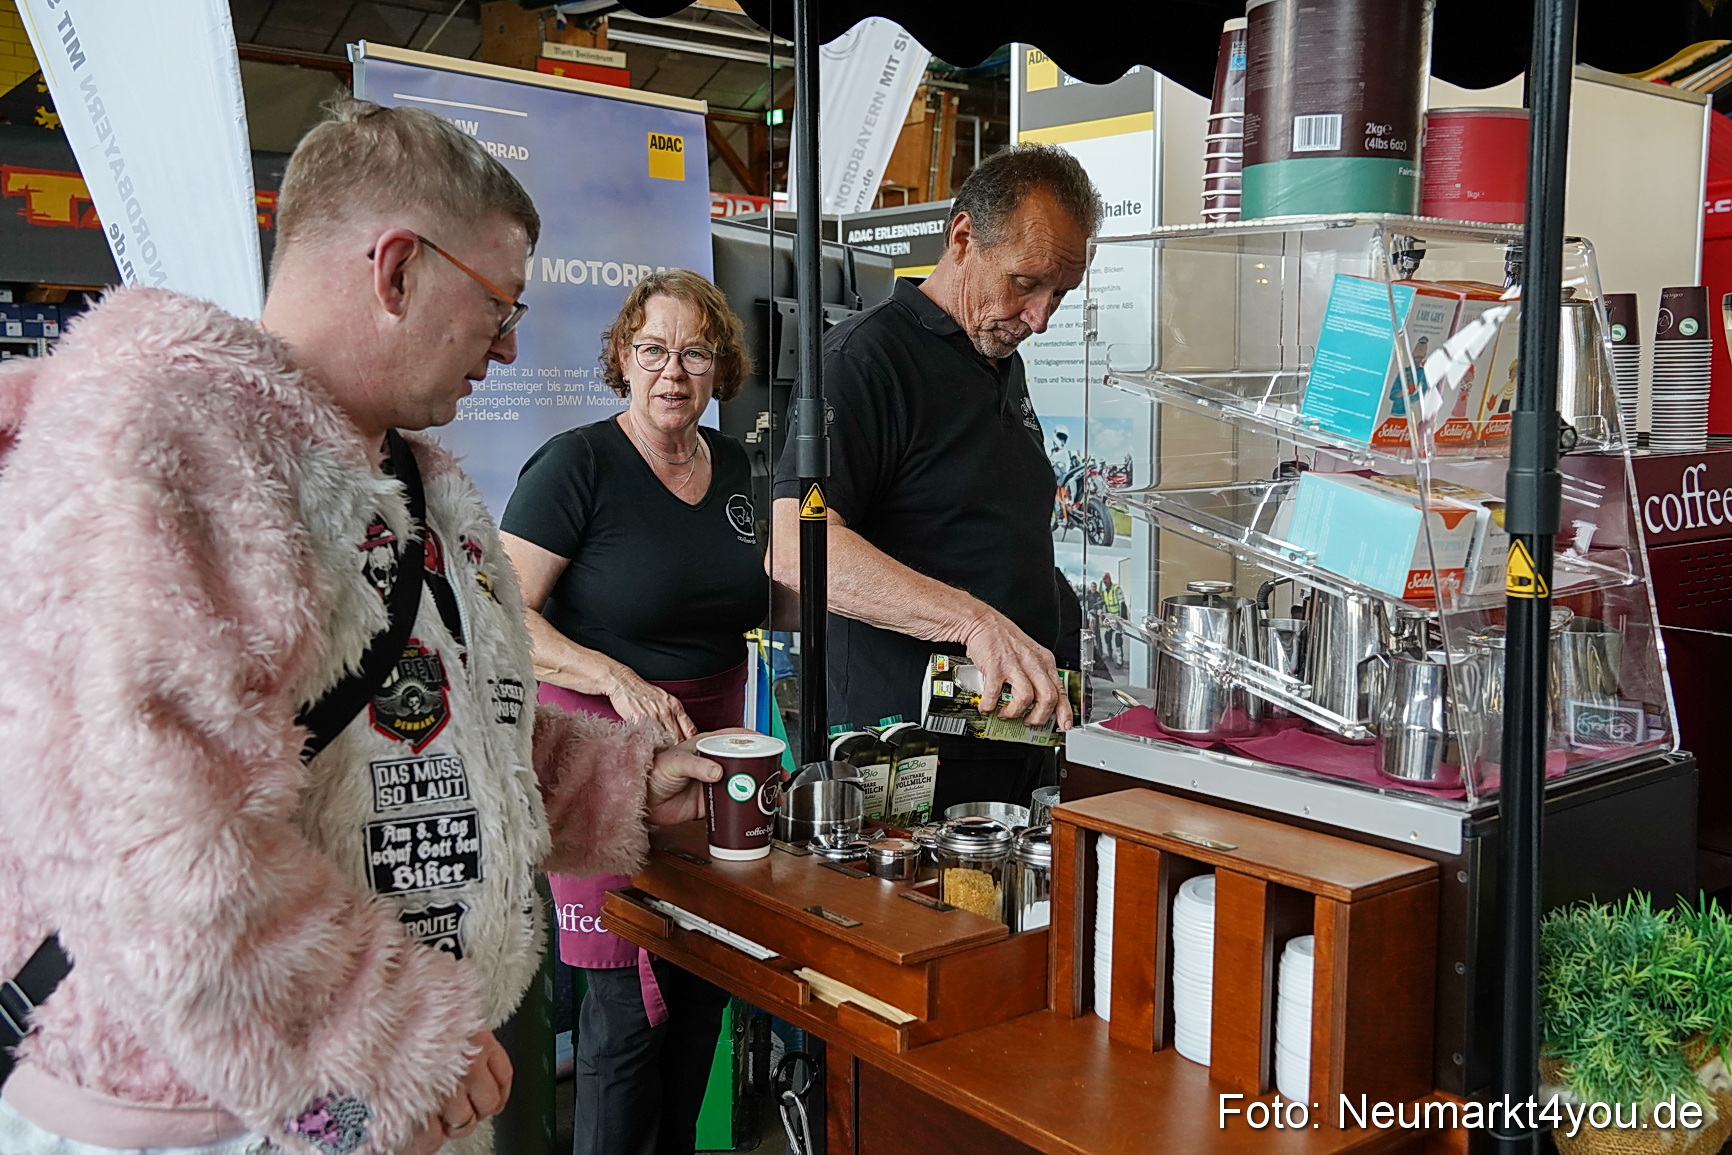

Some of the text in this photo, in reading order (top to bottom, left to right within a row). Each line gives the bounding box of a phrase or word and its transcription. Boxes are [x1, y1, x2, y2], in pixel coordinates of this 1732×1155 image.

[833, 91, 887, 209] NORDBAYERN
[879, 54, 901, 87] MIT
[650, 134, 683, 152] ADAC
[1364, 137, 1407, 152] (4lbs 6oz)
[848, 219, 946, 244] ADAC ERLEBNISWELT
[521, 369, 534, 377] zu
[537, 366, 561, 378] noch
[564, 367, 589, 378] mehr
[547, 381, 561, 392] bis
[564, 384, 585, 392] zum
[535, 397, 553, 406] von
[556, 395, 583, 406] BMW
[393, 714, 436, 731] DENMARK
[377, 758, 462, 787] DAS MUSS
[909, 759, 927, 771] Bio
[379, 778, 464, 806] SO LAUT
[895, 776, 932, 789] VOLLMILCH
[380, 818, 469, 849] Am 8. Tag
[372, 835, 479, 869] schuf Gott den
[391, 860, 466, 890] Biker
[404, 912, 458, 937] ROUTE
